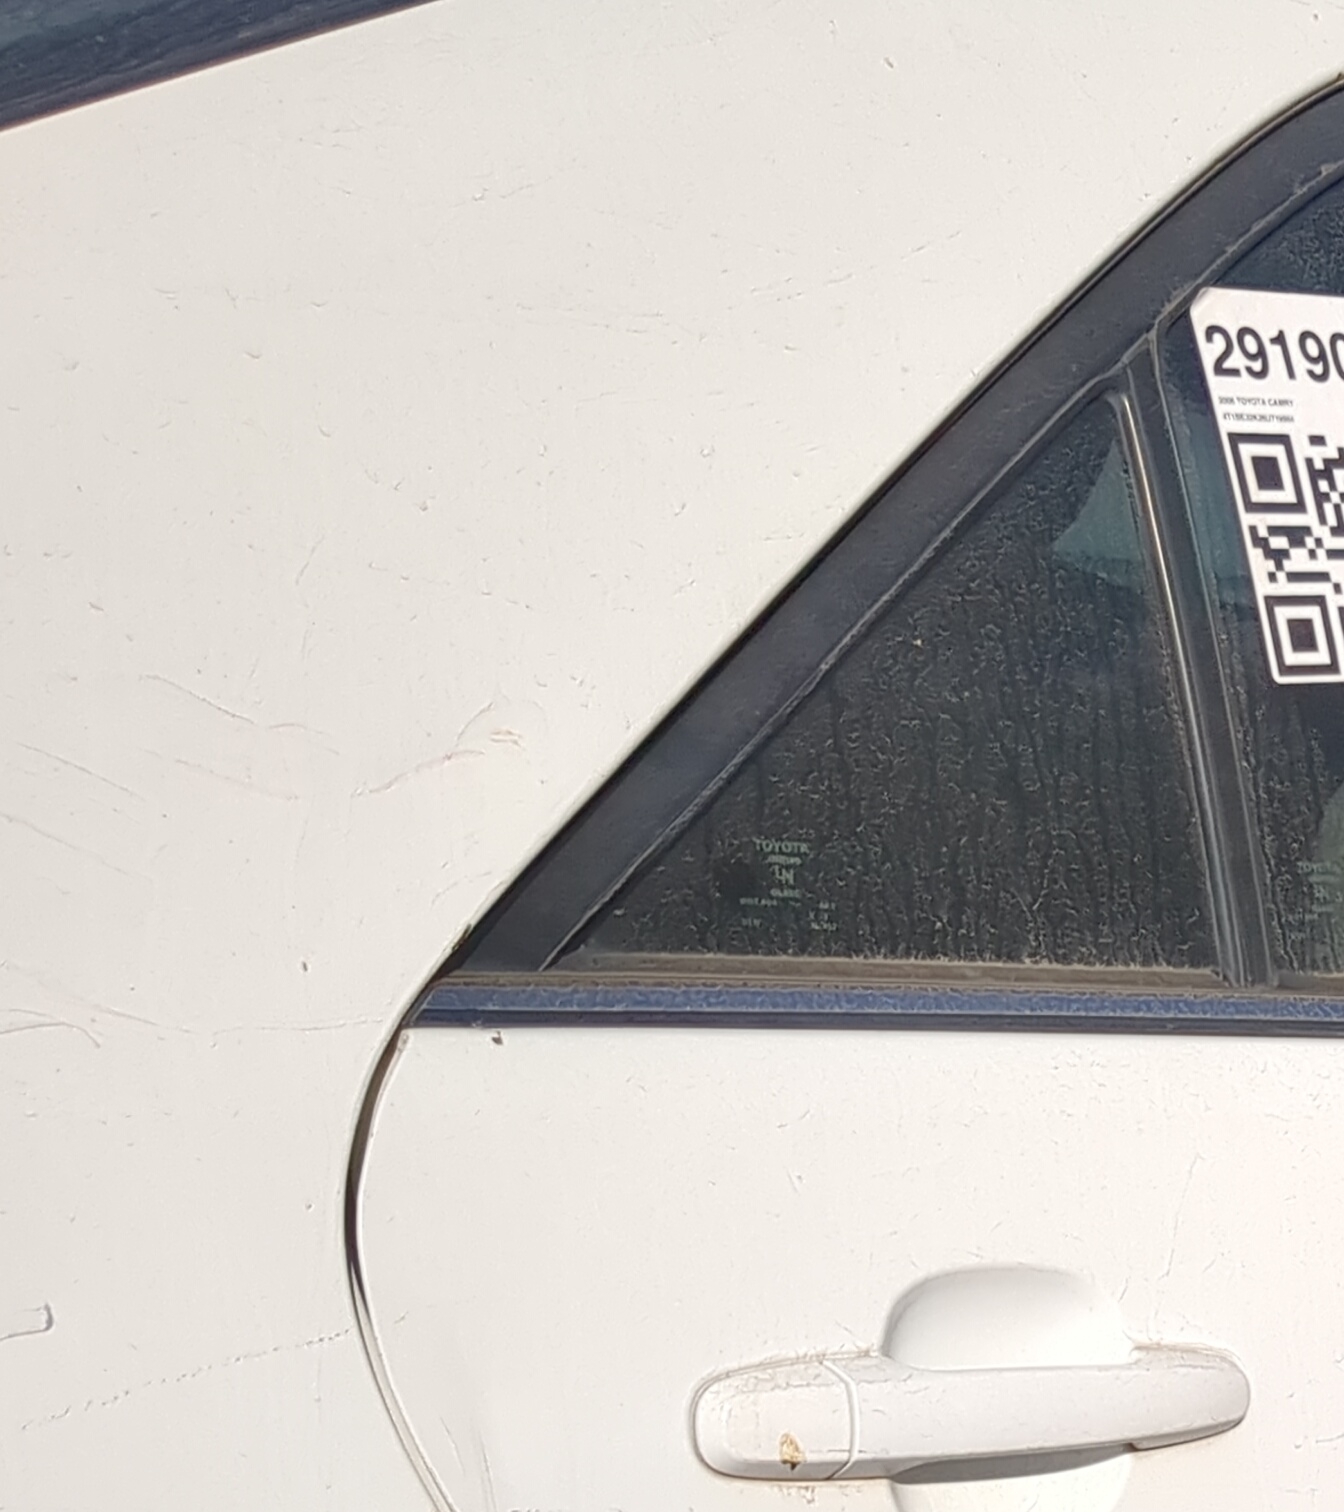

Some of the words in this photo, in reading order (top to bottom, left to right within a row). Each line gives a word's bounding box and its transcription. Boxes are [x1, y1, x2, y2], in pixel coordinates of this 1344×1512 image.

[1236, 396, 1266, 406] TOYOTA
[1267, 398, 1293, 408] CAMRY
[752, 837, 809, 854] TOYOTA
